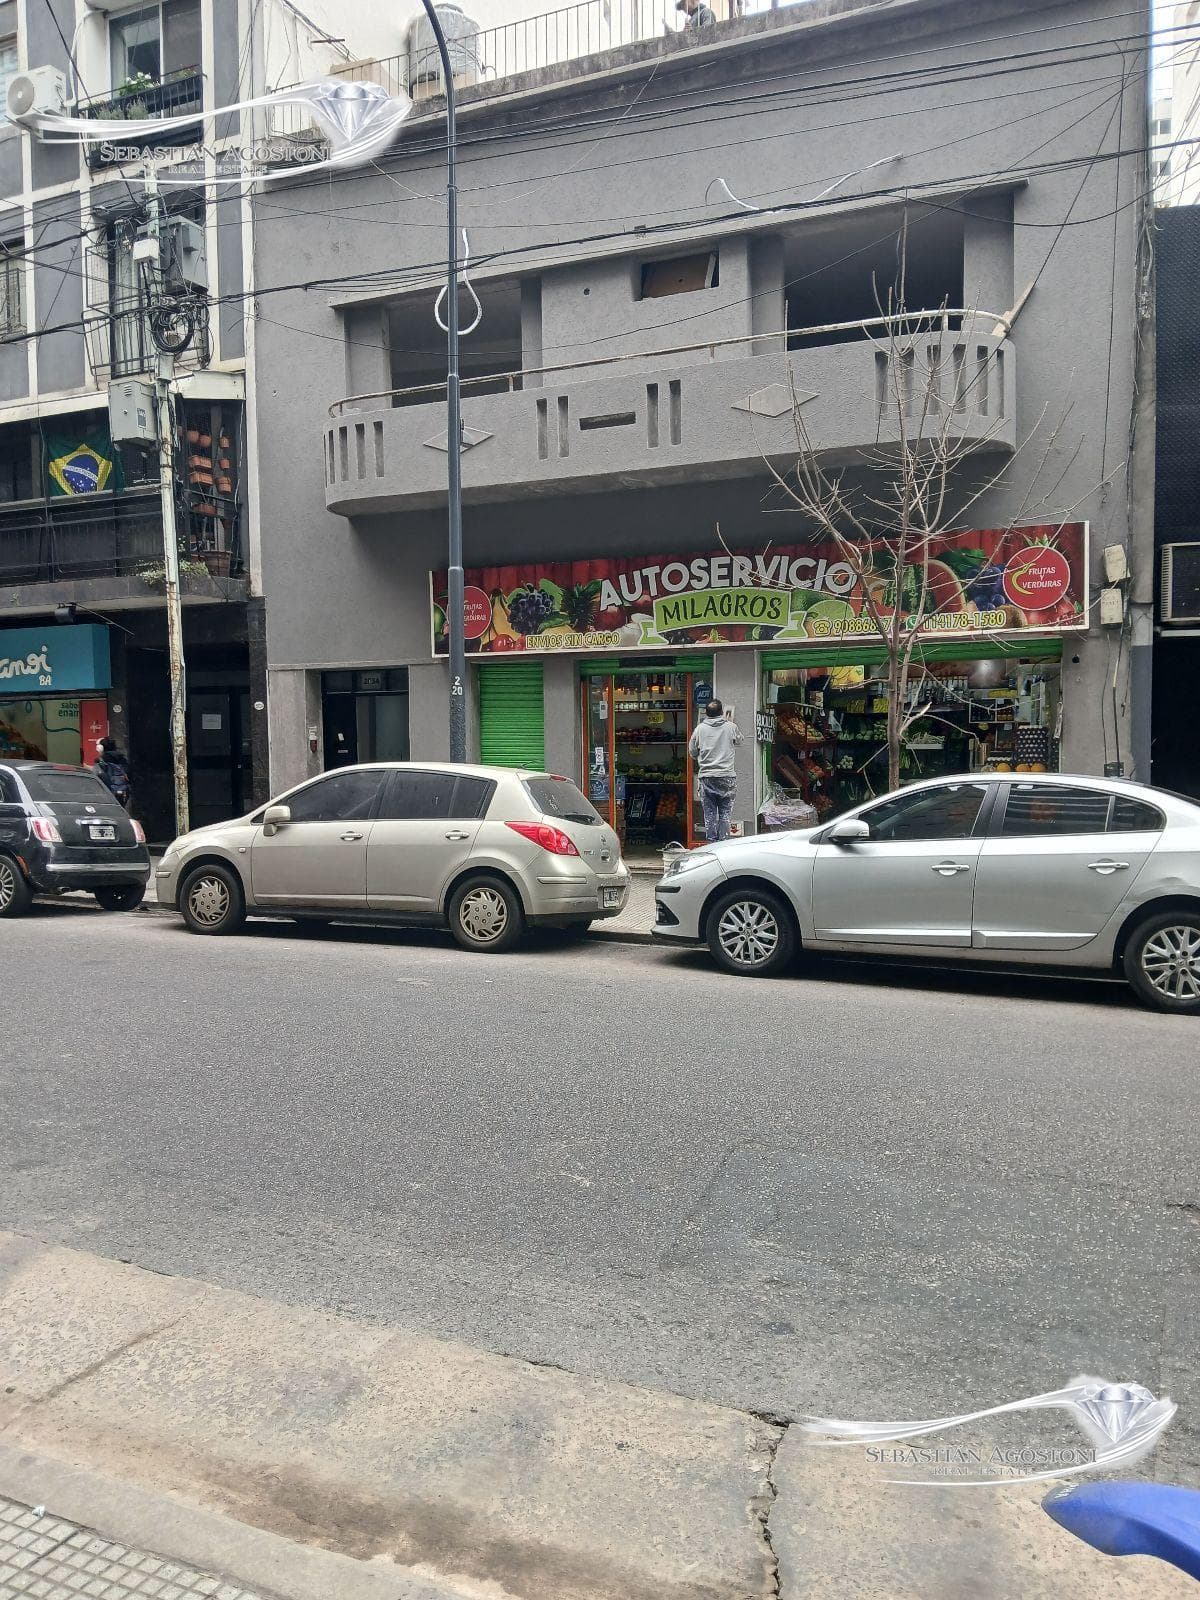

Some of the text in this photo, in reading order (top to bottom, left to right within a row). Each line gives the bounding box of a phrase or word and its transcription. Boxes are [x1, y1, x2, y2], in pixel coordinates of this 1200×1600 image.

[1028, 566, 1056, 576] FRUTAS
[600, 555, 858, 612] AUTOSERVICIO
[1022, 579, 1062, 589] VERDURAS
[661, 592, 783, 626] MILAGROS
[526, 631, 620, 649] ENVIOS SIN CARGO
[39, 674, 52, 686] BA
[454, 676, 461, 686] 2
[452, 686, 463, 695] 20
